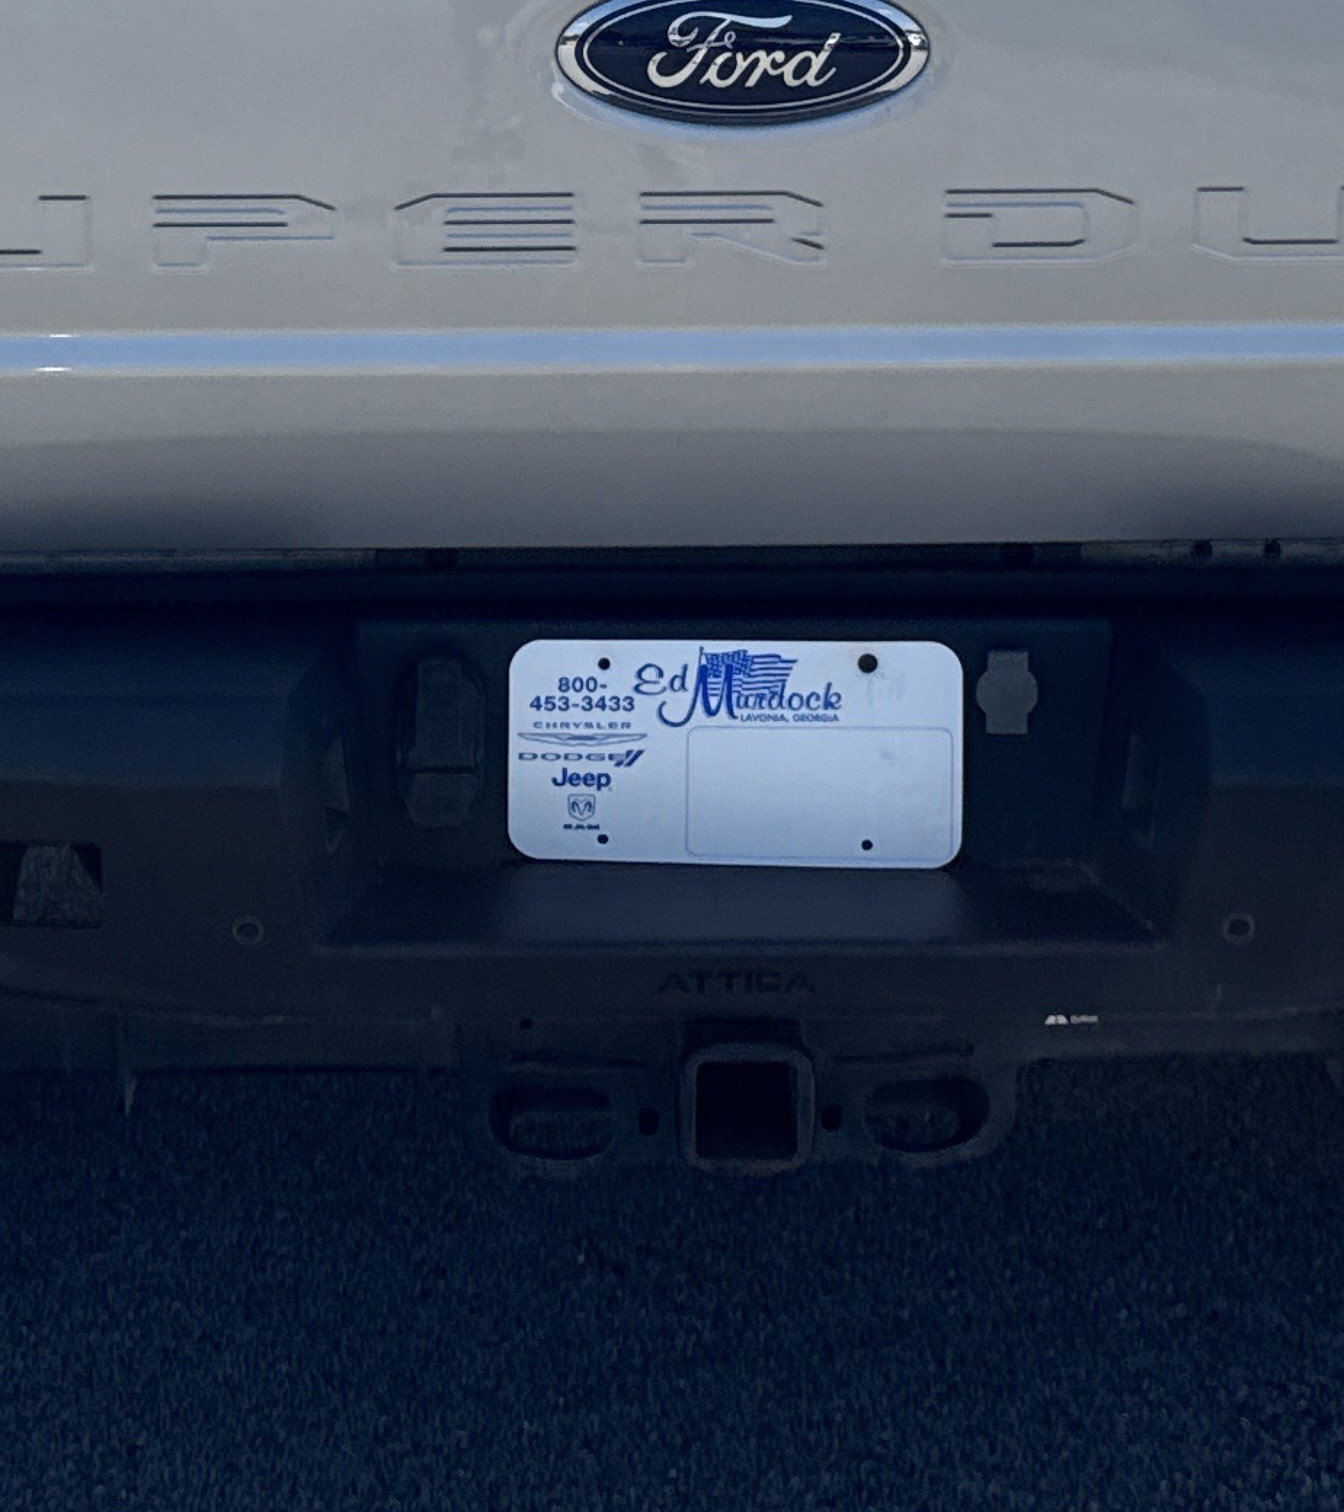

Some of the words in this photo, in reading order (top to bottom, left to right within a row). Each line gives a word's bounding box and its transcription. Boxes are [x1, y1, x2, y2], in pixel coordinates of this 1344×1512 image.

[646, 10, 842, 89] Ford
[557, 676, 608, 693] 800-
[633, 662, 688, 696] Ed
[529, 695, 636, 712] 453-3433
[657, 663, 843, 728] Murdock
[533, 720, 632, 730] CHRYSLER
[518, 752, 626, 762] DODGE
[551, 767, 612, 792] Jeep
[657, 968, 817, 994] ATTICA
